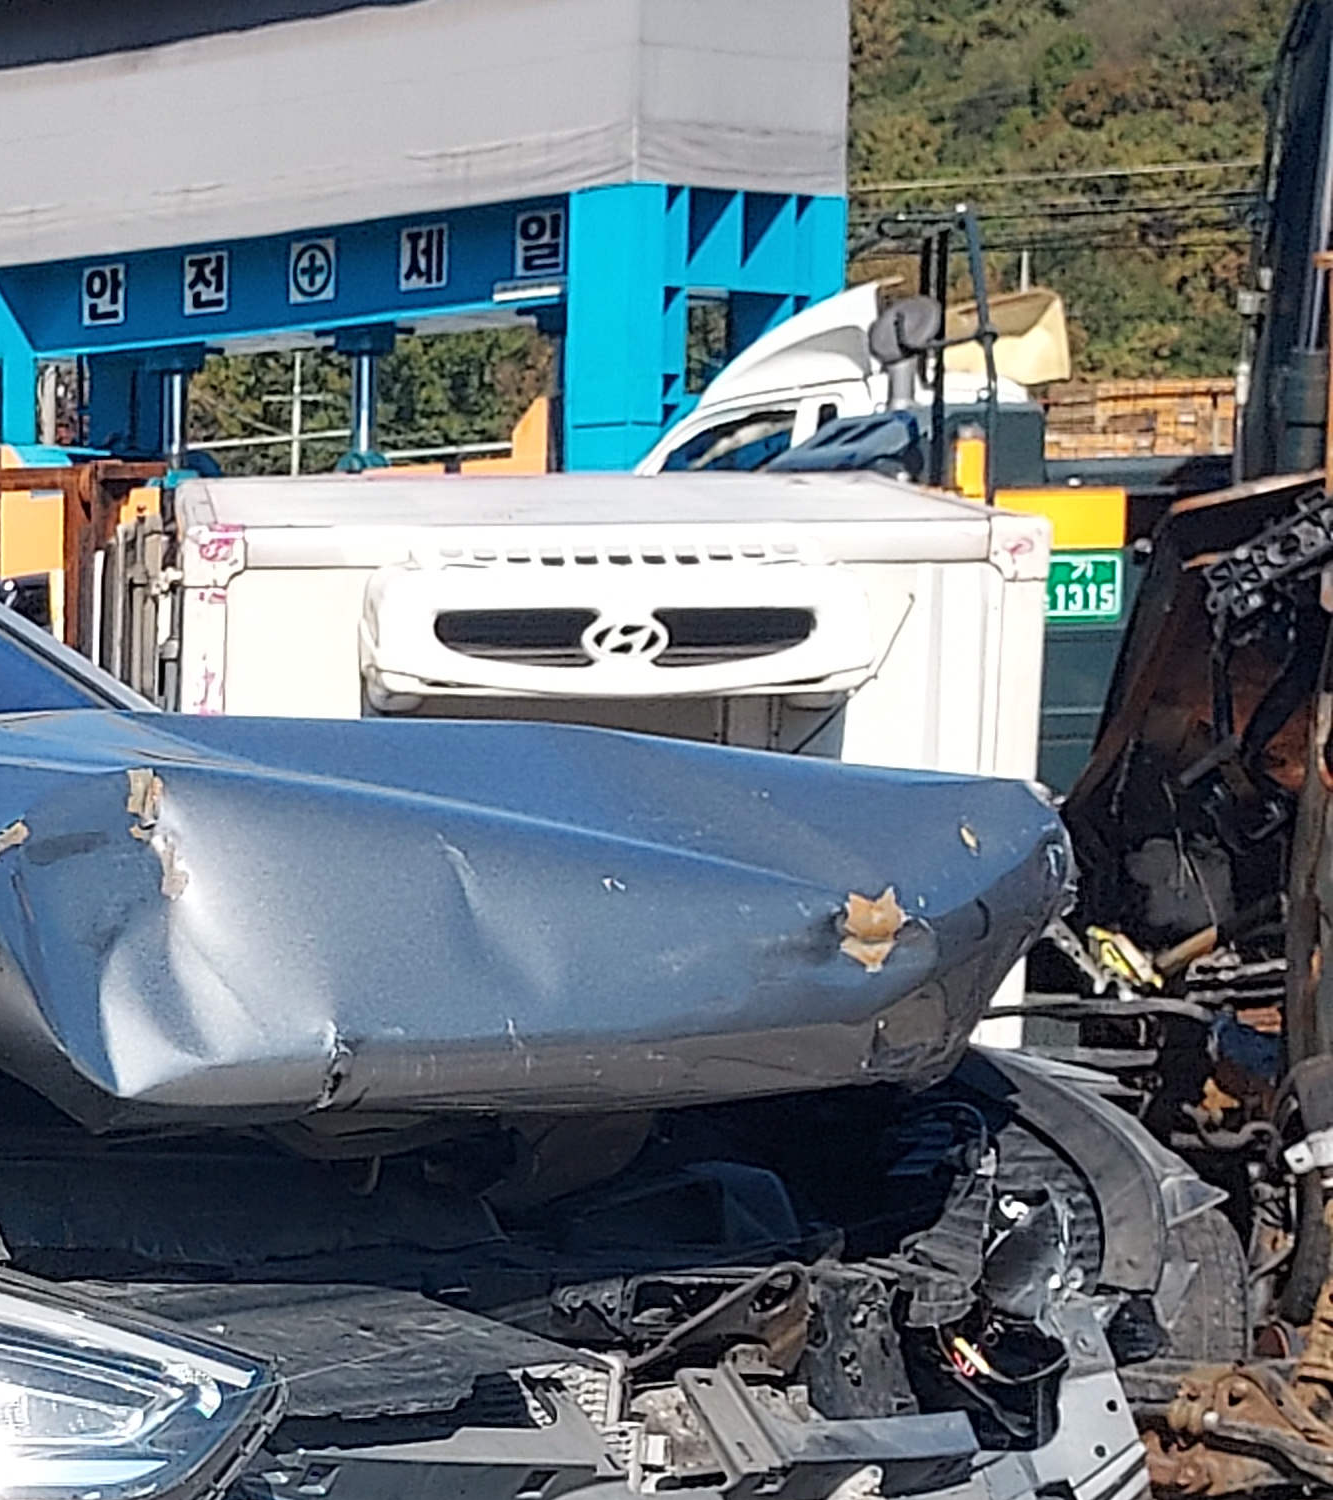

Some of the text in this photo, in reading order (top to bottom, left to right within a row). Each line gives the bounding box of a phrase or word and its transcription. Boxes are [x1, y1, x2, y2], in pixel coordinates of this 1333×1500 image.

[85, 215, 562, 322] 안전 제일
[1055, 583, 1115, 612] 1315
